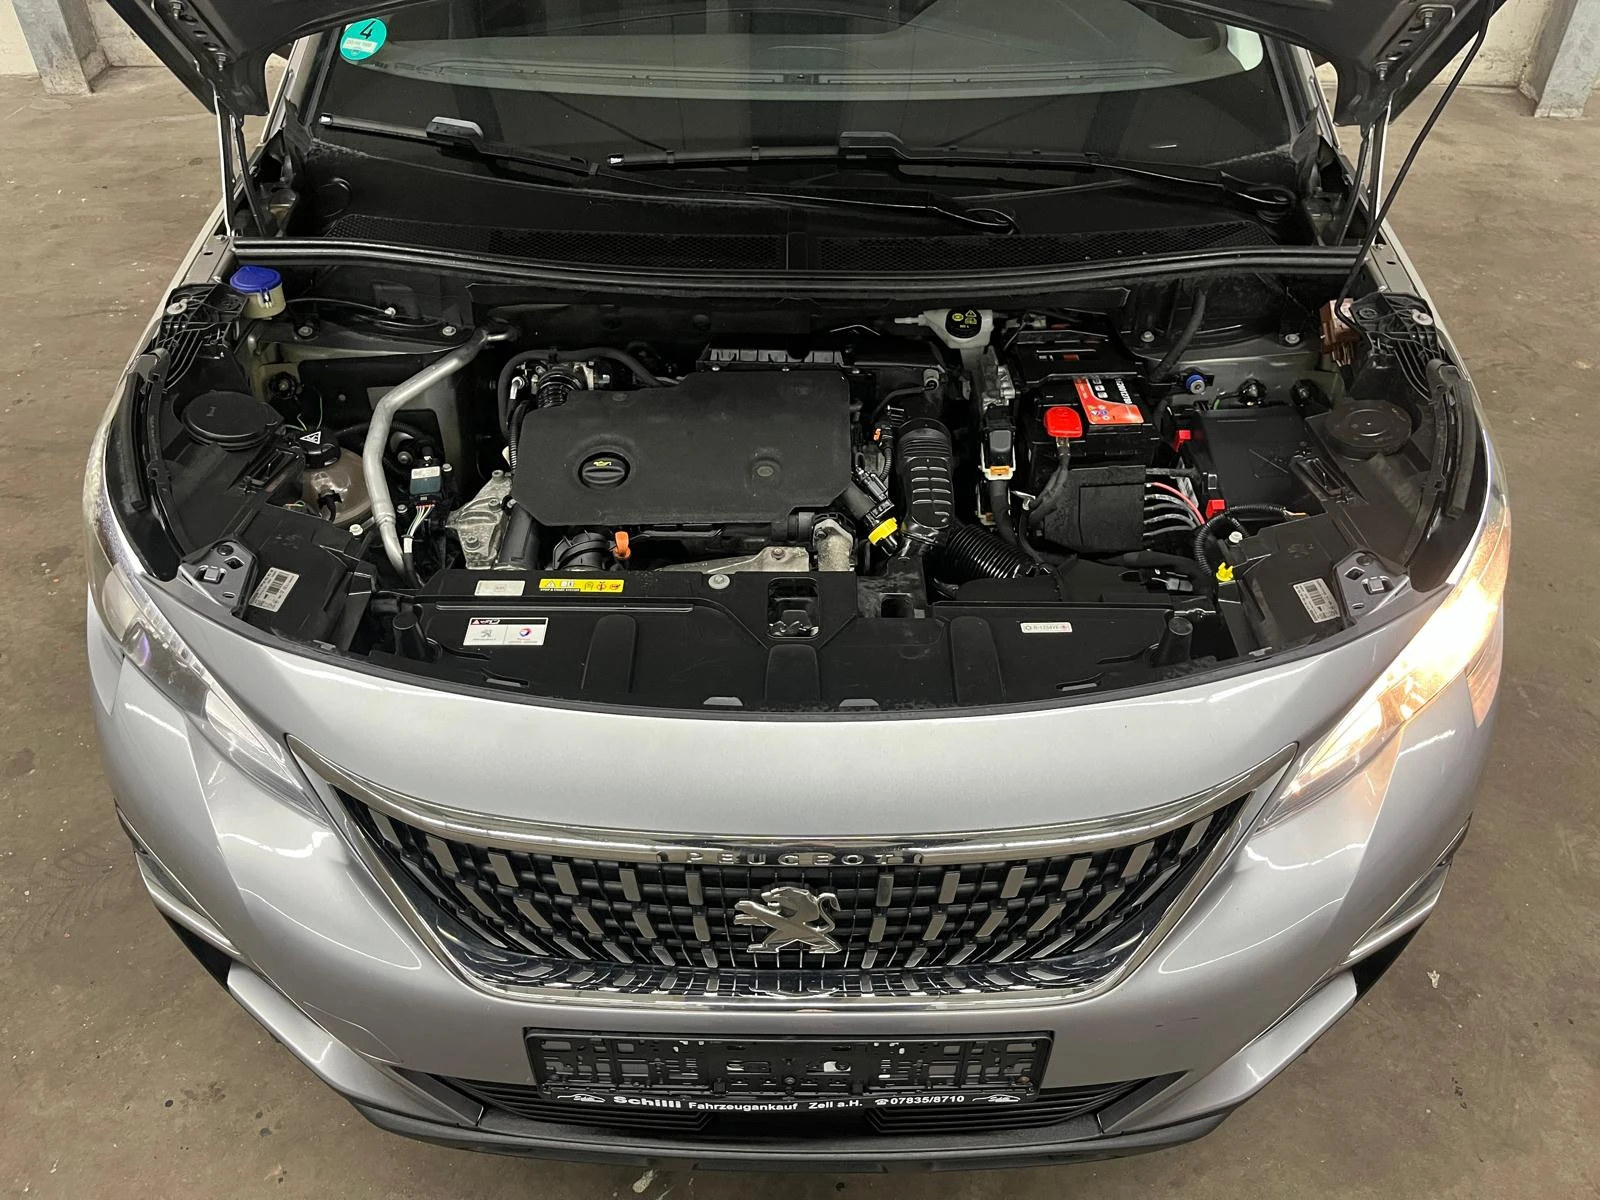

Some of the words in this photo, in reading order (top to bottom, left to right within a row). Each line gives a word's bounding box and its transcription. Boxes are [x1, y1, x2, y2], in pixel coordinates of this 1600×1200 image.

[360, 20, 376, 39] 4
[687, 852, 894, 866] PEUGEOT
[688, 1102, 798, 1112] Fahrzeugankauf
[808, 1101, 833, 1110] Zell
[837, 1099, 863, 1108] a.H.
[890, 1095, 965, 1105] 07835/8710
